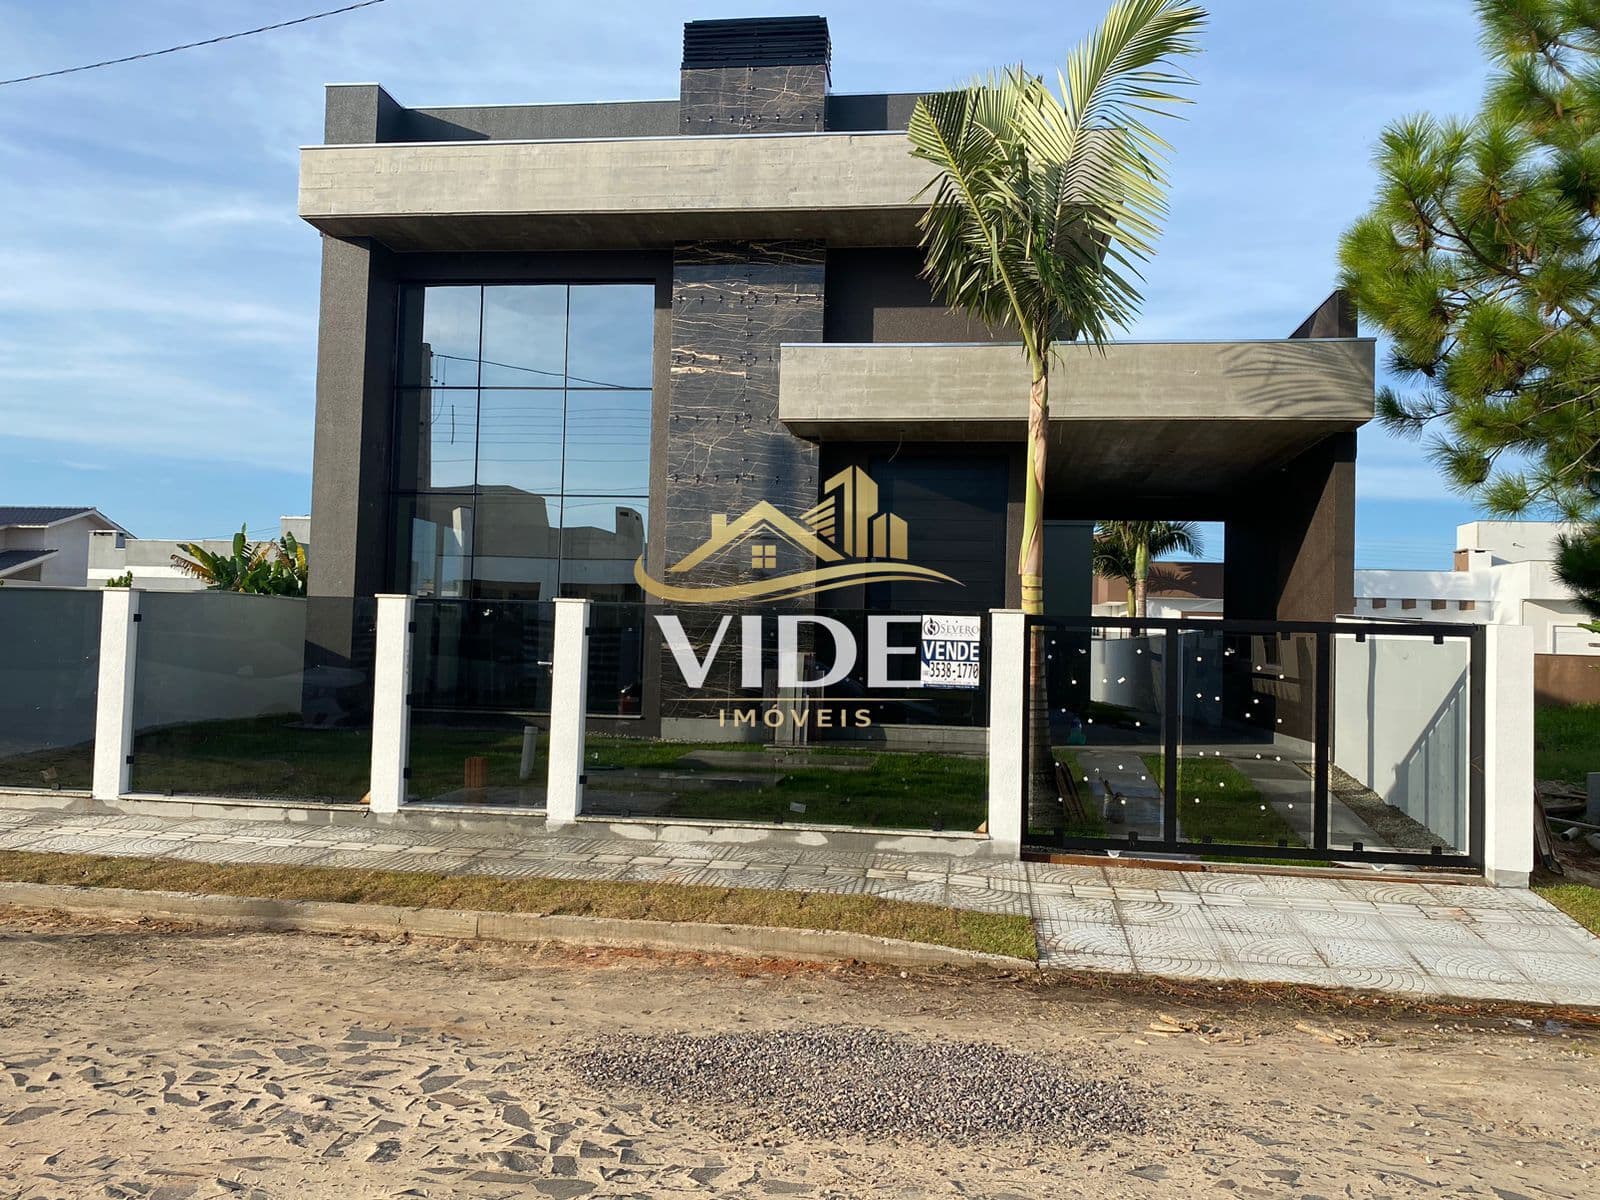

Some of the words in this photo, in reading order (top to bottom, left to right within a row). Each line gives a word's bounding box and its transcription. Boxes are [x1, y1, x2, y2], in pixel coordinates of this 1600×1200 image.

[940, 623, 979, 636] SEVERO
[922, 641, 980, 661] VENDE
[929, 662, 979, 679] 3538-1770
